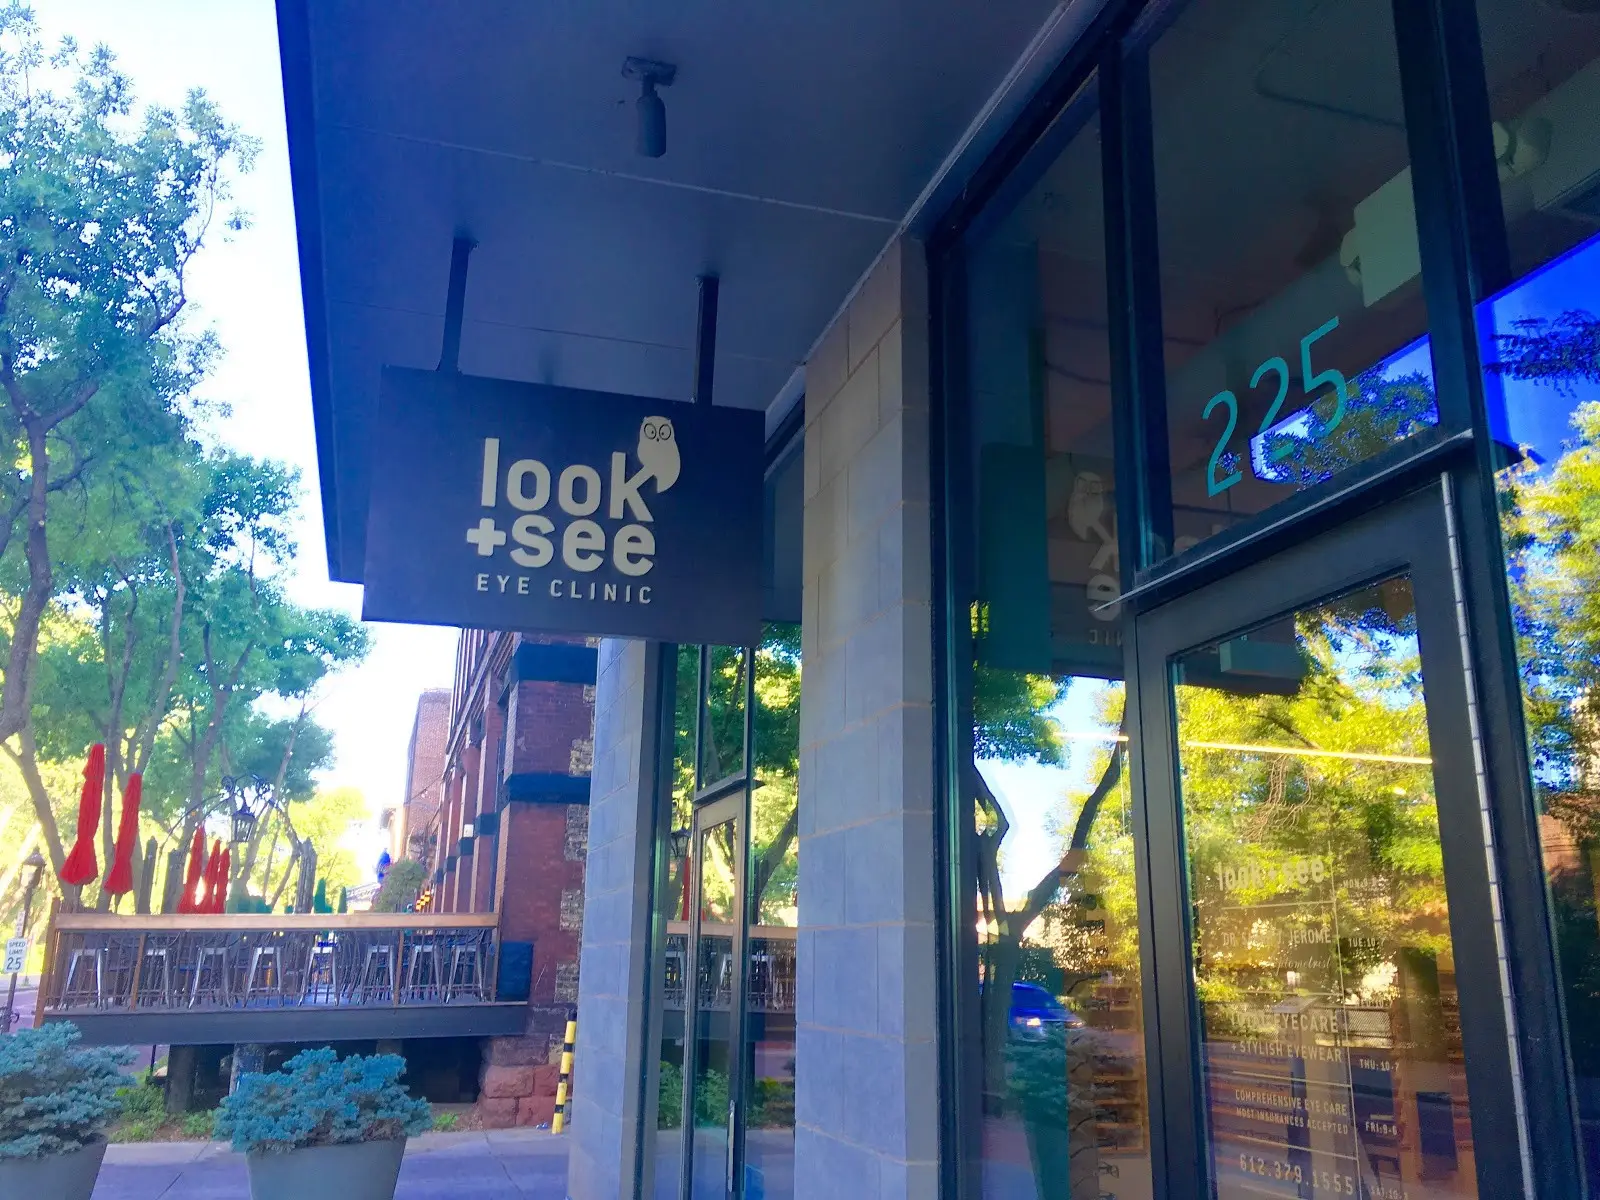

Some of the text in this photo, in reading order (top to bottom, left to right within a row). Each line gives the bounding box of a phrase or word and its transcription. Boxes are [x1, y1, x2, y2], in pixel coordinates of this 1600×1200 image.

[1201, 315, 1348, 498] 225
[480, 437, 655, 522] look
[476, 573, 652, 605] EYE CLINIC
[1289, 926, 1332, 945] JEROME
[6, 956, 22, 971] 25
[1277, 1010, 1339, 1033] EYECARE
[1240, 1040, 1283, 1057] STYLISH
[1287, 1044, 1343, 1062] EYEWEAR
[1235, 1089, 1347, 1117] COMPREHENSIVE EYE CARE
[1307, 1119, 1348, 1135] ACCEPTED
[1239, 1153, 1354, 1195] 612.379.1555
